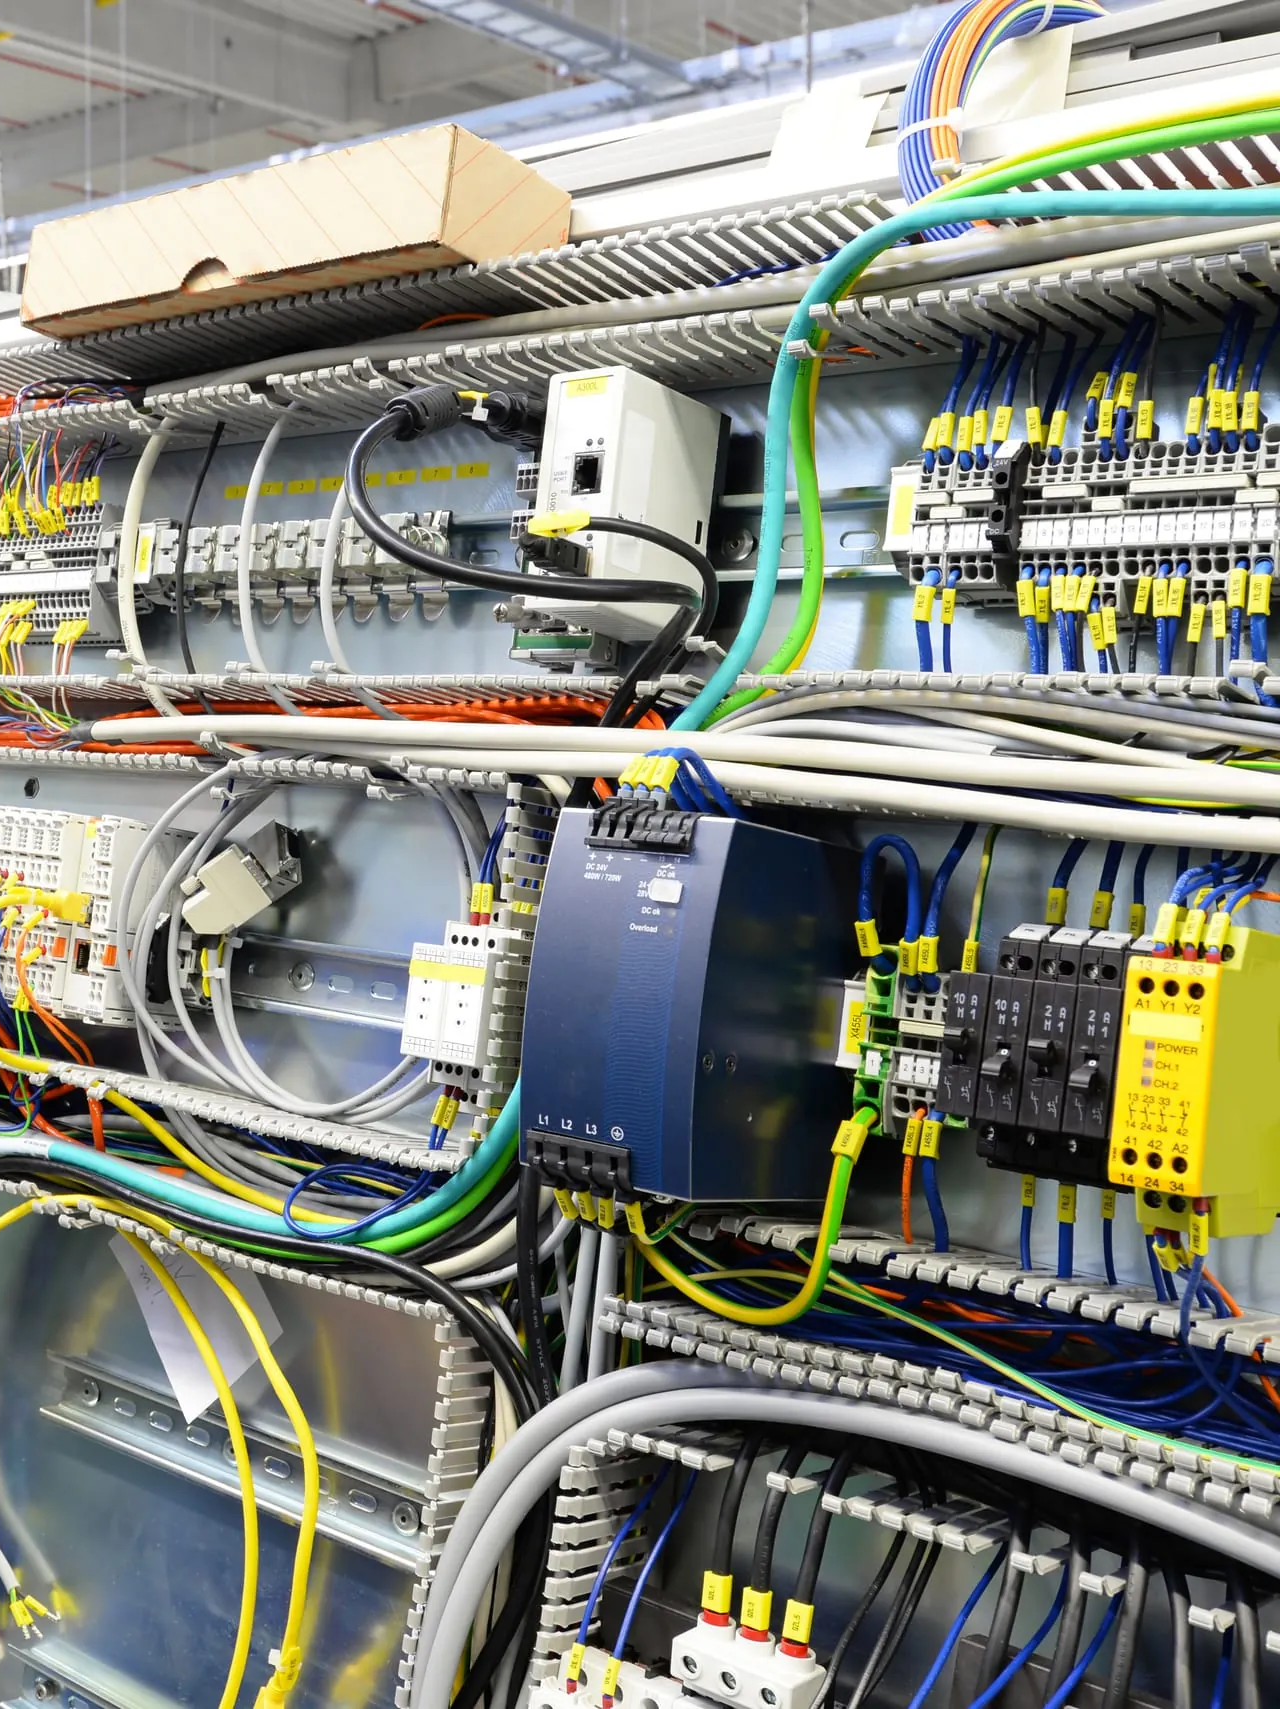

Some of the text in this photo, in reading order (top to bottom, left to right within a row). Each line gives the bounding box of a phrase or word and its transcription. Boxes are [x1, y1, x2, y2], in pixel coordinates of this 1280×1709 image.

[656, 870, 666, 878] DC
[629, 923, 658, 933] Overload
[1140, 960, 1204, 976] 13 23 33
[953, 992, 978, 1007] 10 A
[995, 999, 1020, 1013] 10 A
[1135, 998, 1200, 1015] A1 Y1 Y2
[970, 1009, 977, 1020] 1
[1045, 1005, 1067, 1019] 2 A
[1088, 1010, 1111, 1024] 2 A
[851, 1013, 863, 1039] X455L
[1011, 1015, 1018, 1027] 1
[1057, 1021, 1064, 1033] 1
[1101, 1026, 1108, 1038] 1
[1157, 1043, 1198, 1055] POWER
[1155, 1060, 1179, 1072] CH.1
[1154, 1079, 1179, 1091] CH.2
[1128, 1092, 1191, 1109] 13 23 33 41
[539, 1113, 597, 1135] L1 L2 L3
[1125, 1120, 1189, 1137] 14 24 34 42
[1123, 1135, 1189, 1155] 41 42 A2
[1120, 1172, 1185, 1192] 14 24 34
